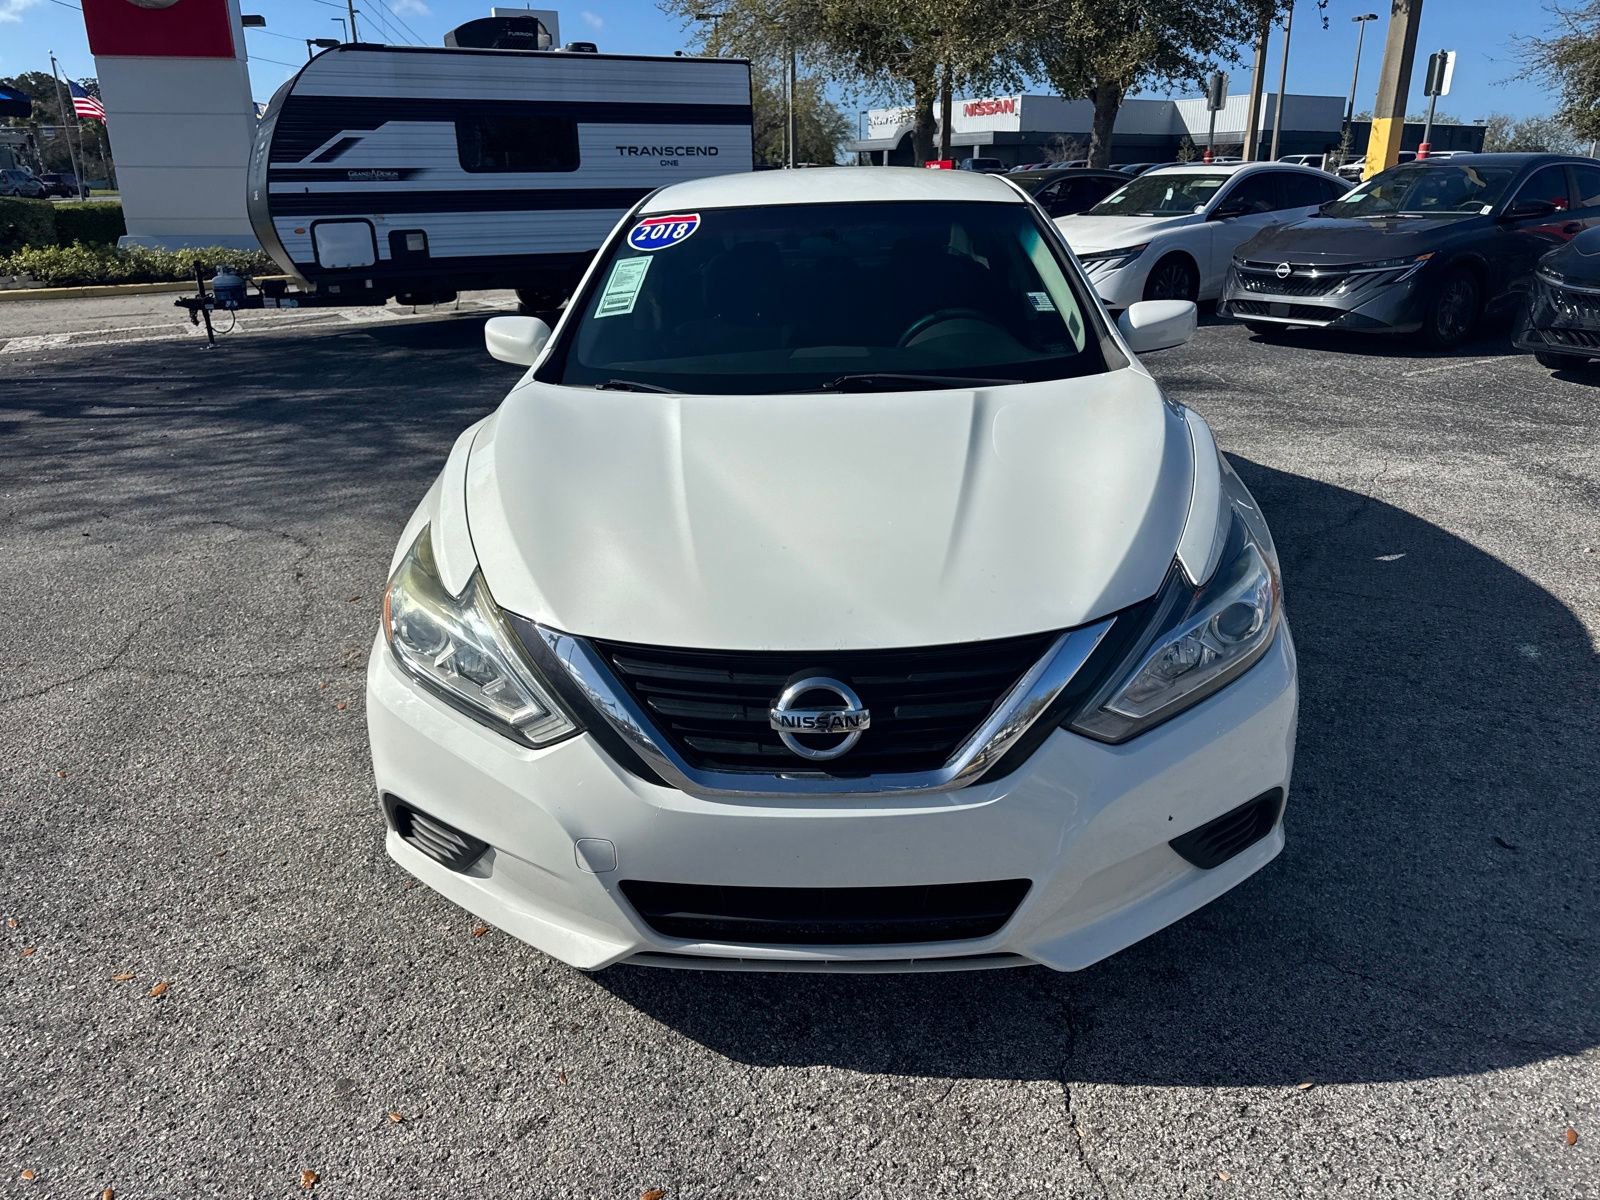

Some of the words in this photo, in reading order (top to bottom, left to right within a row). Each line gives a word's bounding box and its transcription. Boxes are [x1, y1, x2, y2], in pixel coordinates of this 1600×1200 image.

[964, 100, 1015, 116] NISSAN
[616, 146, 719, 156] TRANSCEND
[634, 223, 689, 241] 2018
[781, 715, 860, 728] NISSAN
